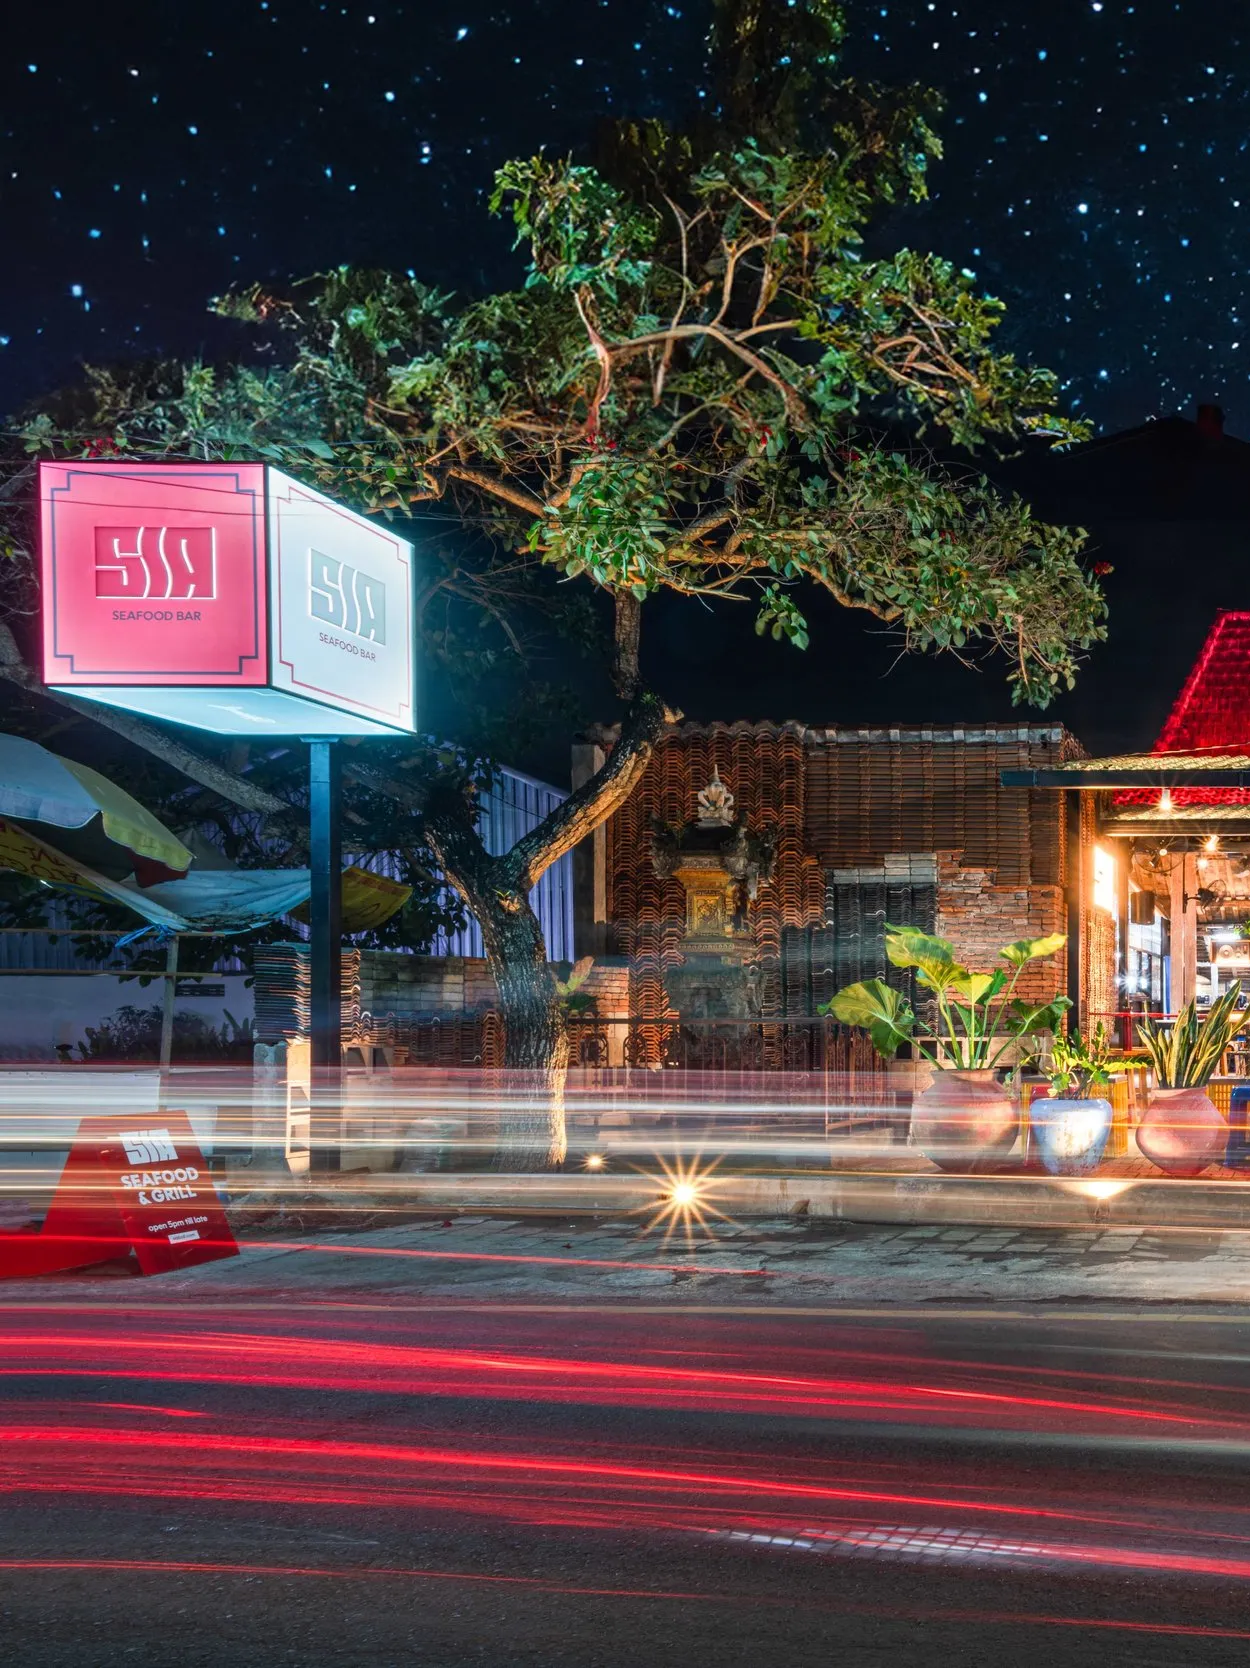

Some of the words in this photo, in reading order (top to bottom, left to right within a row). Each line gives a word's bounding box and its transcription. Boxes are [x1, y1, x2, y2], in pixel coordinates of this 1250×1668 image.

[112, 610, 173, 621] SEAFOOD
[176, 611, 201, 621] BAR
[319, 632, 360, 655] SEAFOOD
[360, 648, 377, 662] BAR
[120, 1167, 199, 1189] SEAFOOD
[138, 1191, 152, 1206] &
[151, 1185, 197, 1203] GRILL
[148, 1222, 168, 1232] open
[167, 1219, 185, 1230] 5pm
[185, 1217, 194, 1225] till
[193, 1215, 208, 1223] late
